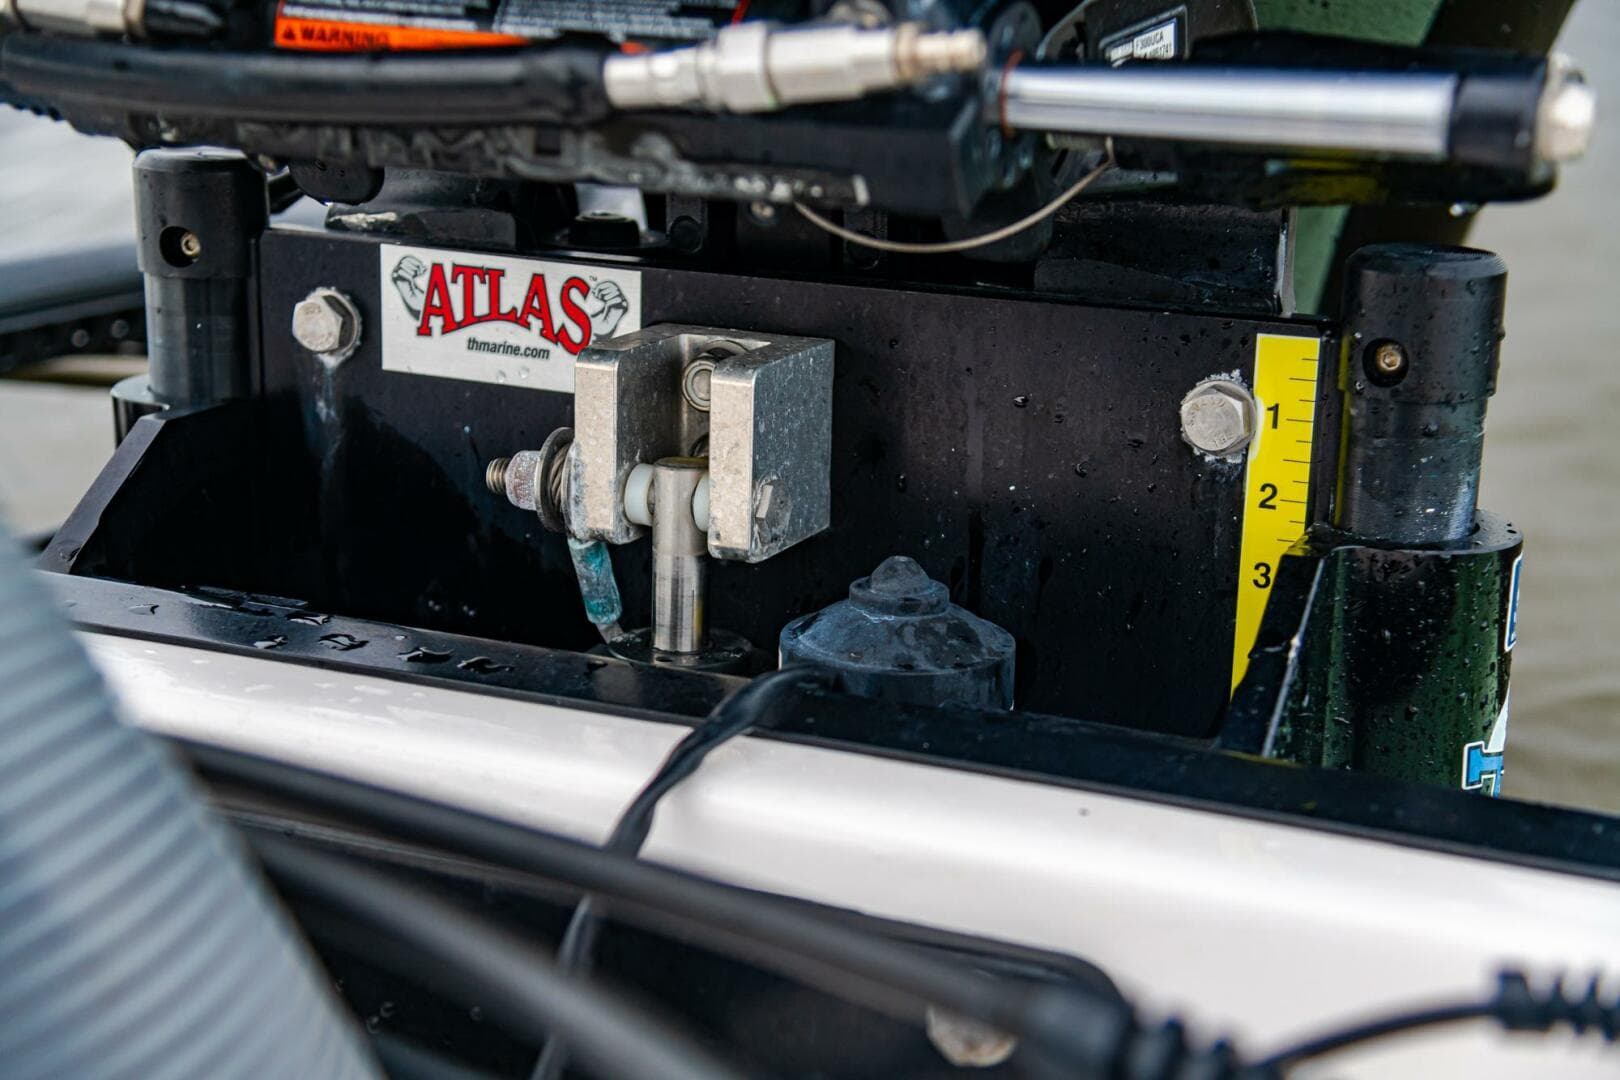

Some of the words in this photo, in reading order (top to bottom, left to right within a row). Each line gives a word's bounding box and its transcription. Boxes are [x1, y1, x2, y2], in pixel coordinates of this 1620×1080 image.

[300, 26, 390, 51] WARNING
[416, 262, 592, 355] ATLAS
[467, 337, 550, 360] thmarine.com
[1266, 402, 1280, 430] 1
[1258, 482, 1278, 510] 2
[1252, 562, 1272, 589] 3
